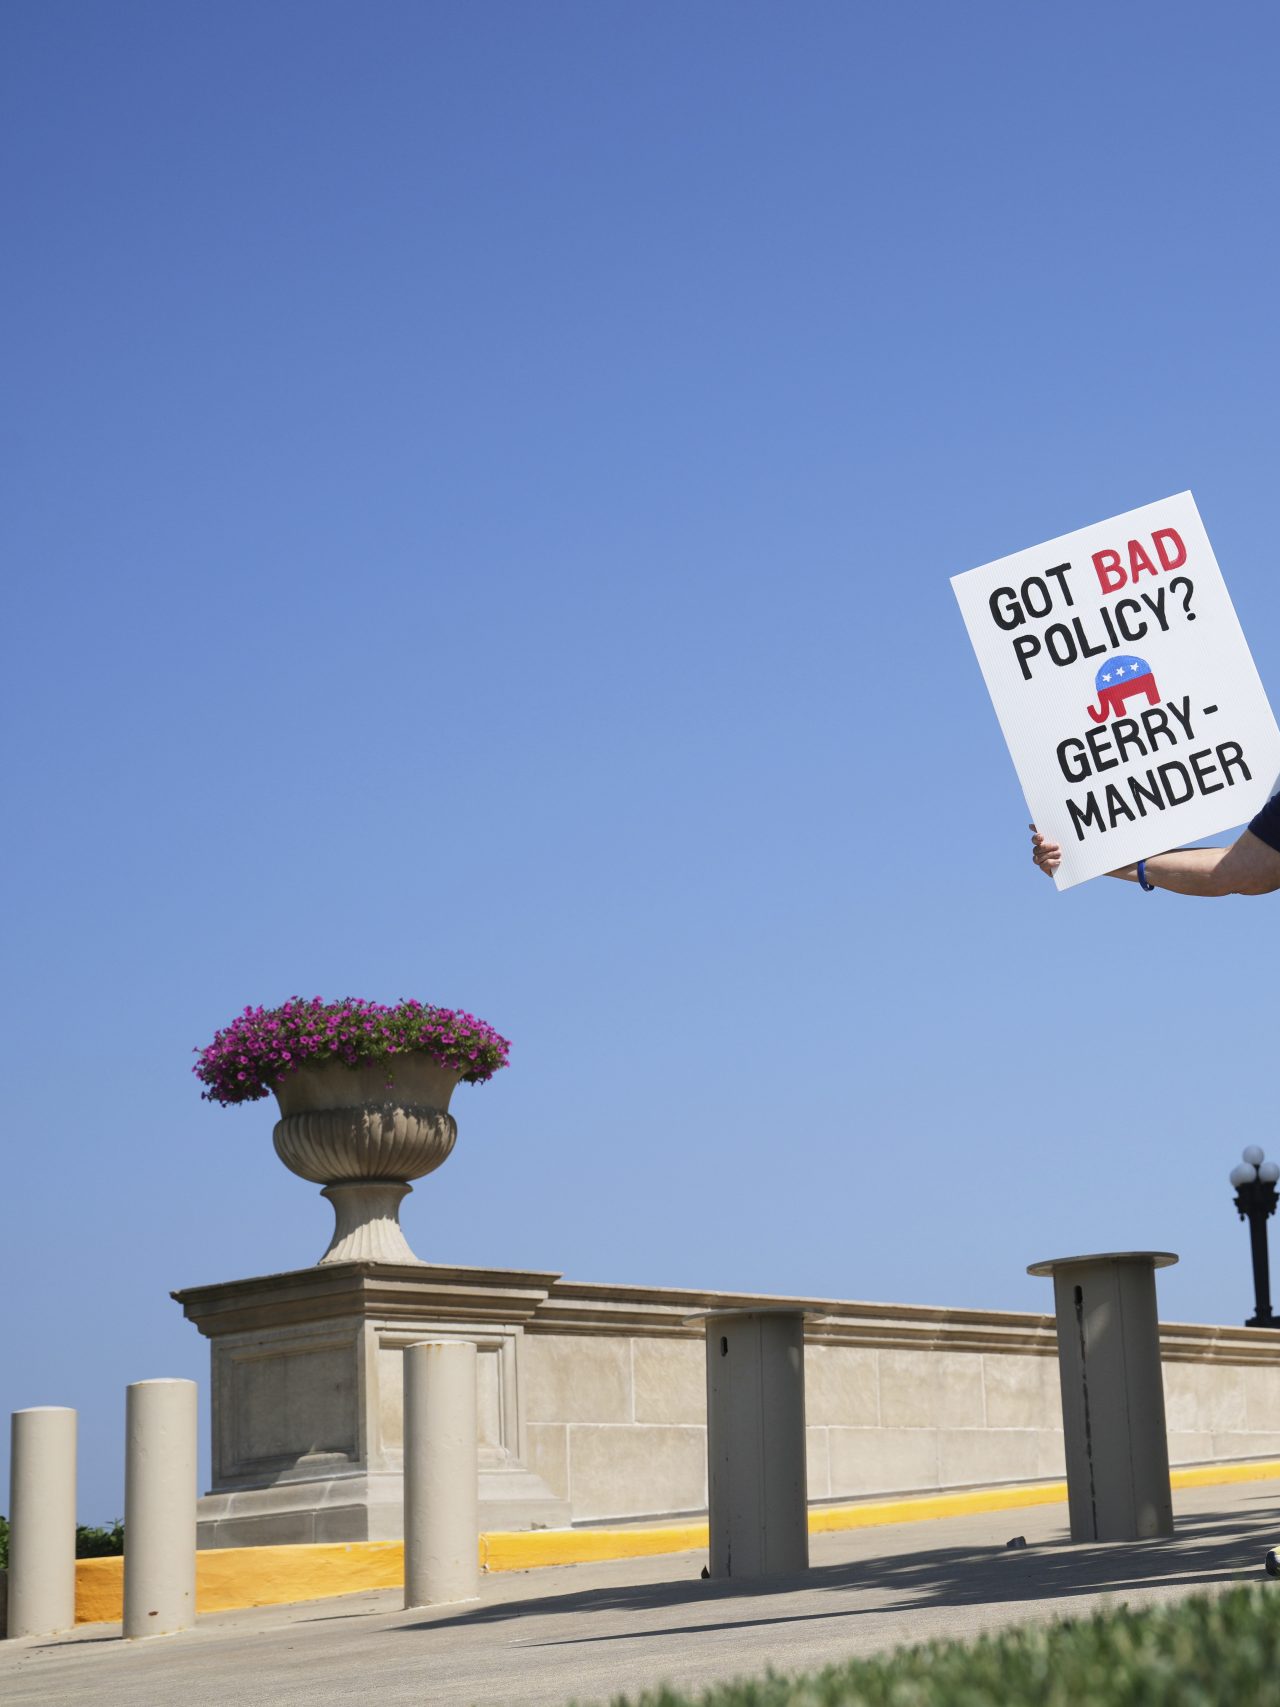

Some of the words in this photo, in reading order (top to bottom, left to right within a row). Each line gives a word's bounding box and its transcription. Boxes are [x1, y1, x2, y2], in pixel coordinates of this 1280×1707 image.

[988, 562, 1074, 631] GOT
[1091, 527, 1187, 595] BAD
[1012, 576, 1196, 681] POLICY?
[1065, 741, 1253, 842] MANDER
